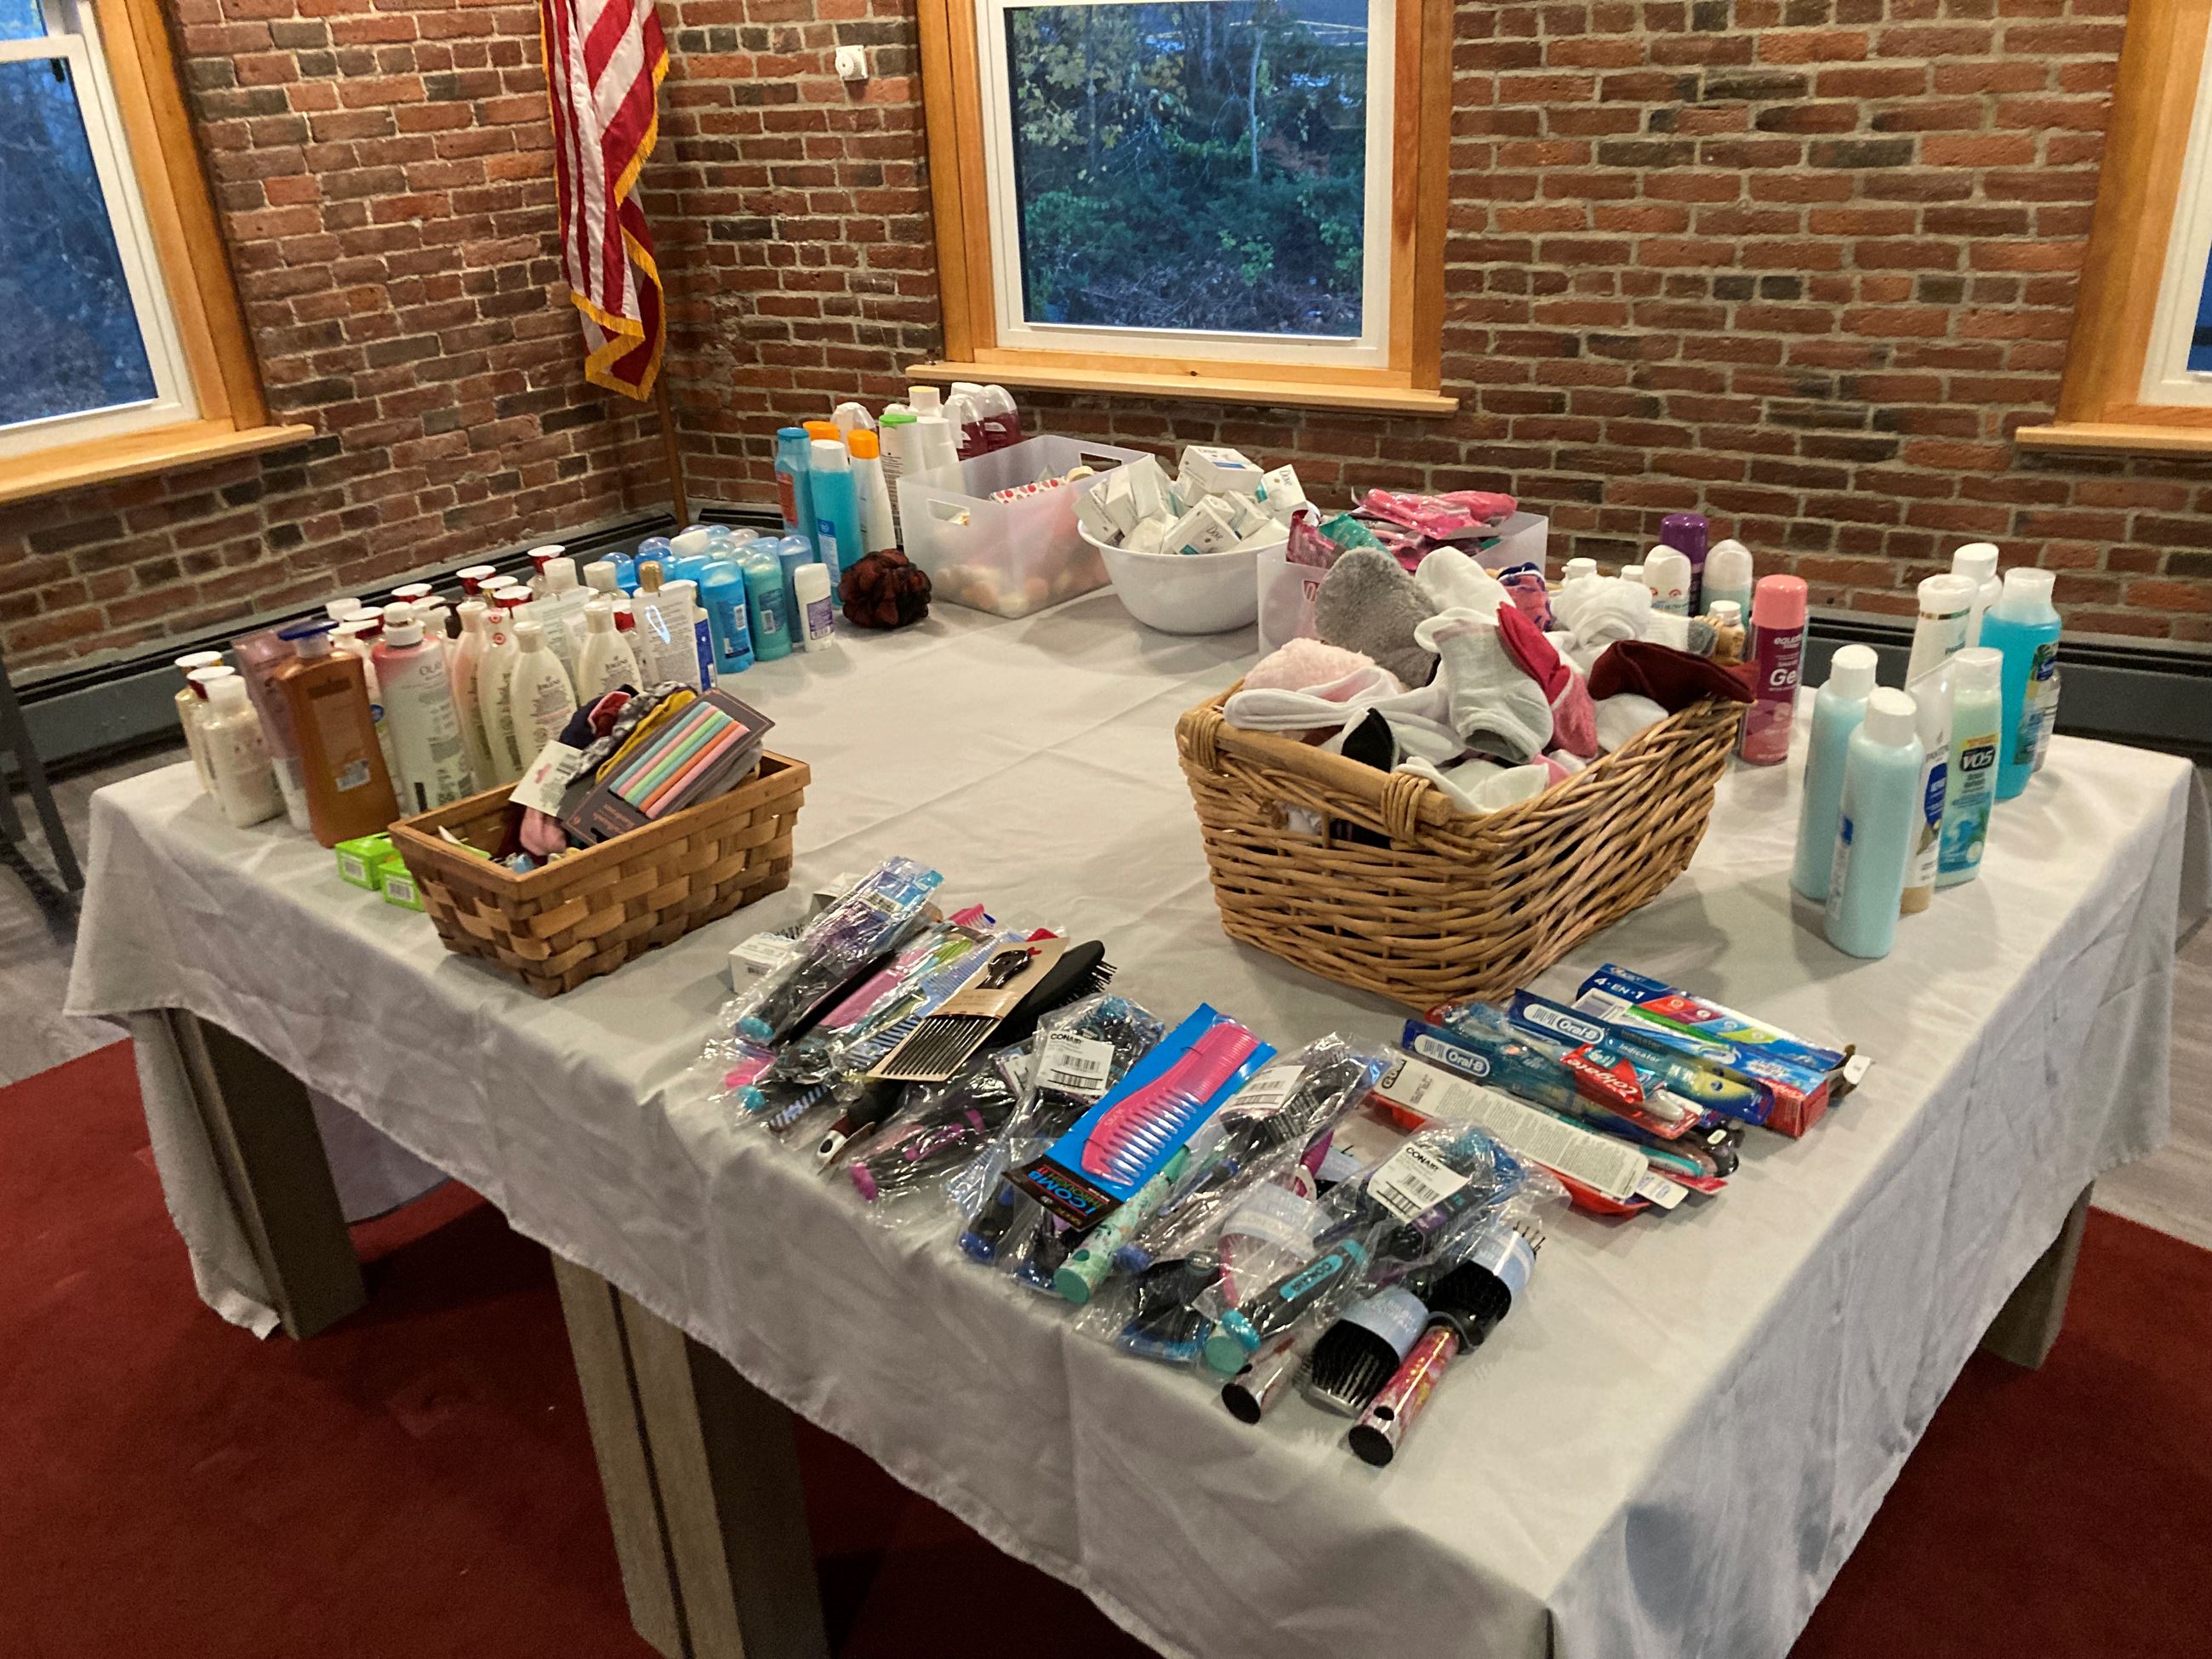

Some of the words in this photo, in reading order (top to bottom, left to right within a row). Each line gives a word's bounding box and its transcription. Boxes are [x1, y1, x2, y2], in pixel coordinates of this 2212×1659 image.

[1280, 469, 1292, 487] Dove
[1206, 524, 1224, 540] Dove
[1770, 668, 1798, 687] Ge
[1962, 750, 1993, 770] VO5
[1050, 1033, 1082, 1045] CONAIR
[1559, 1020, 1598, 1040] Oral-B
[1448, 1051, 1485, 1072] Oral-B
[1567, 1058, 1639, 1095] Colgate
[1405, 1146, 1440, 1172] CONAIR
[1028, 1170, 1087, 1209] COMB
[1086, 1206, 1097, 1215] I
